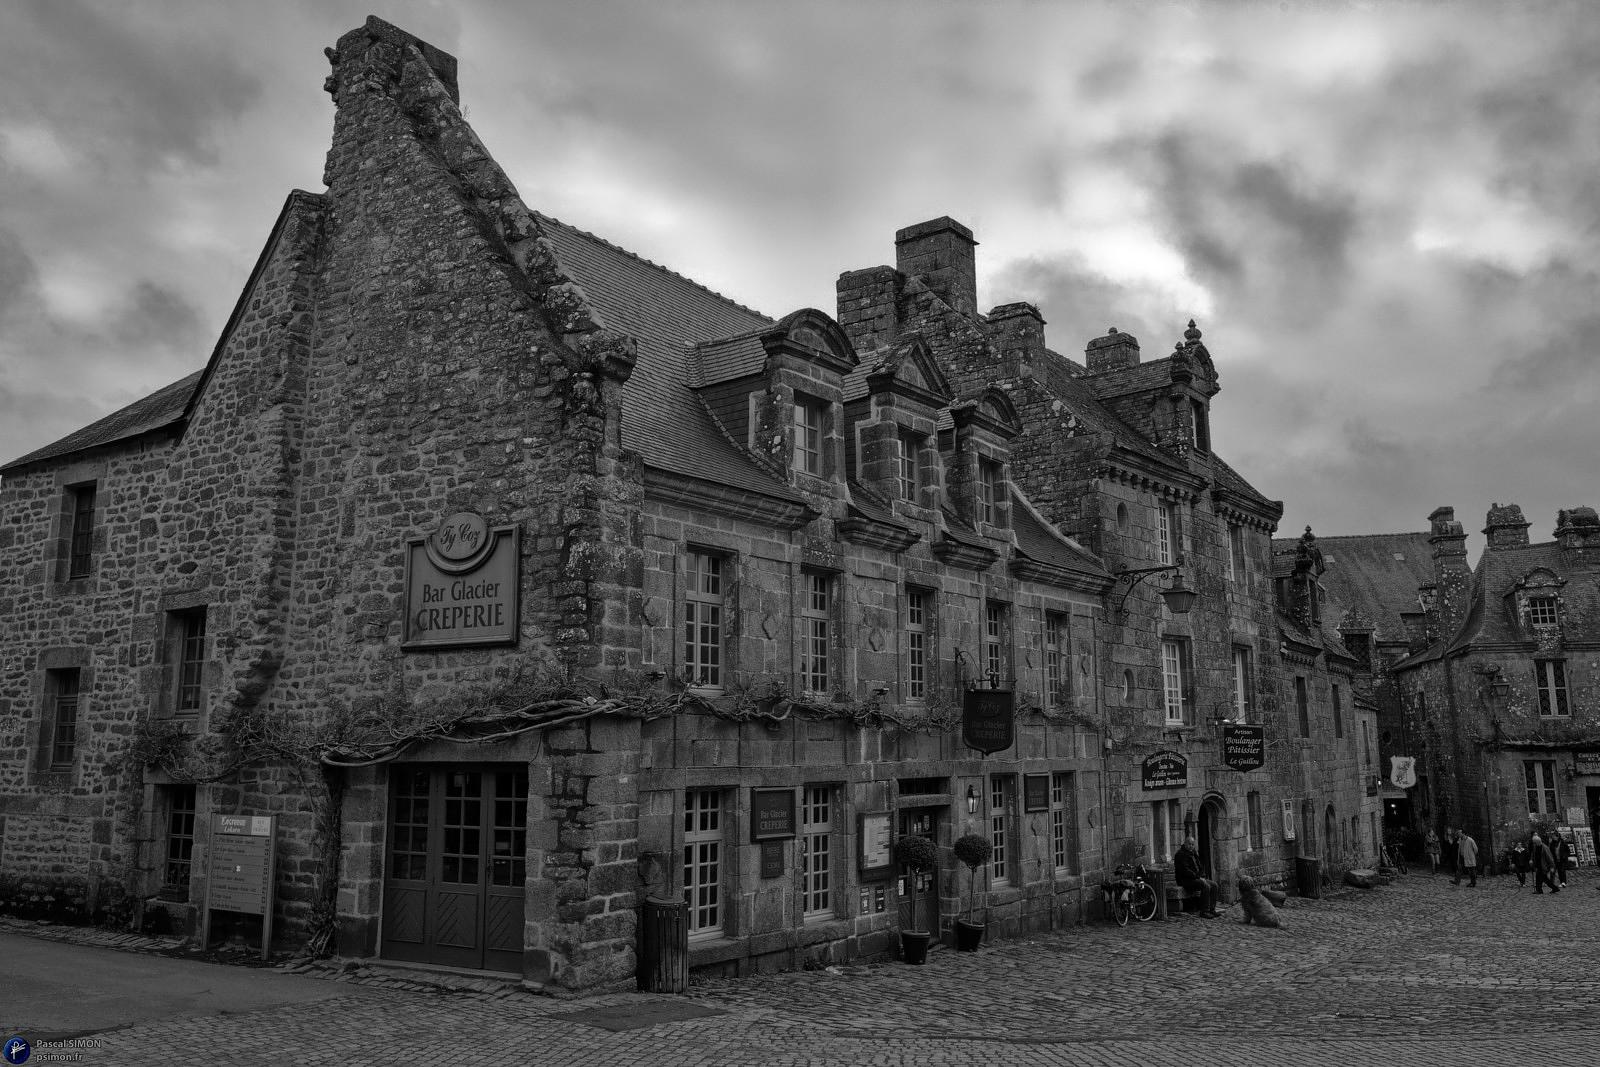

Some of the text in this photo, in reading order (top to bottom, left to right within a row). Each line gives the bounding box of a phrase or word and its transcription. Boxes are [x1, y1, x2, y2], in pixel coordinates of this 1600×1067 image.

[440, 523, 480, 552] Ty Coz
[423, 580, 500, 603] Bar Glacier
[416, 603, 505, 631] CREPERIE
[1225, 736, 1262, 748] Boulanger
[1227, 745, 1260, 754] Pâtissier
[1229, 757, 1238, 765] Le
